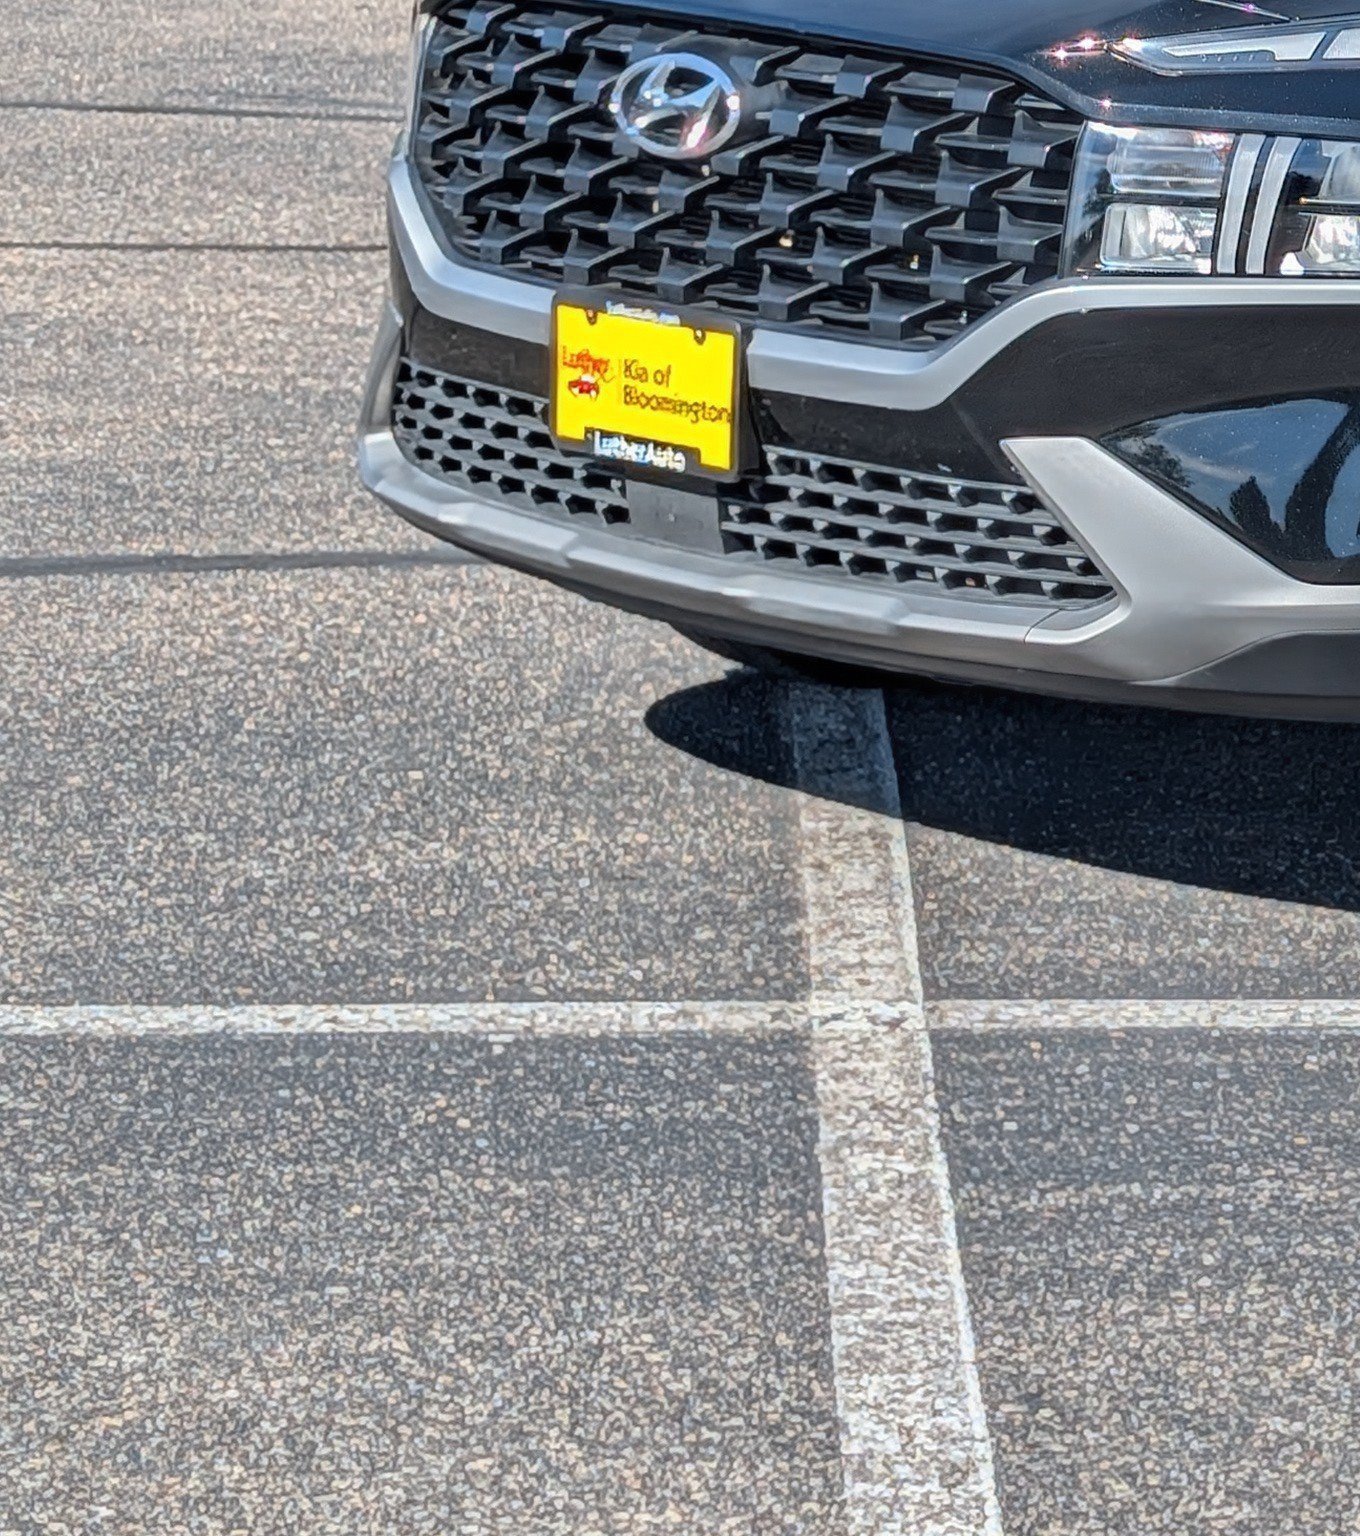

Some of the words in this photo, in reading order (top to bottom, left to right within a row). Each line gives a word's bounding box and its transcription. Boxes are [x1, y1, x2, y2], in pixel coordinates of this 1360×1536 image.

[623, 358, 649, 384] Kia
[652, 363, 672, 388] of
[623, 383, 733, 424] Bloomington
